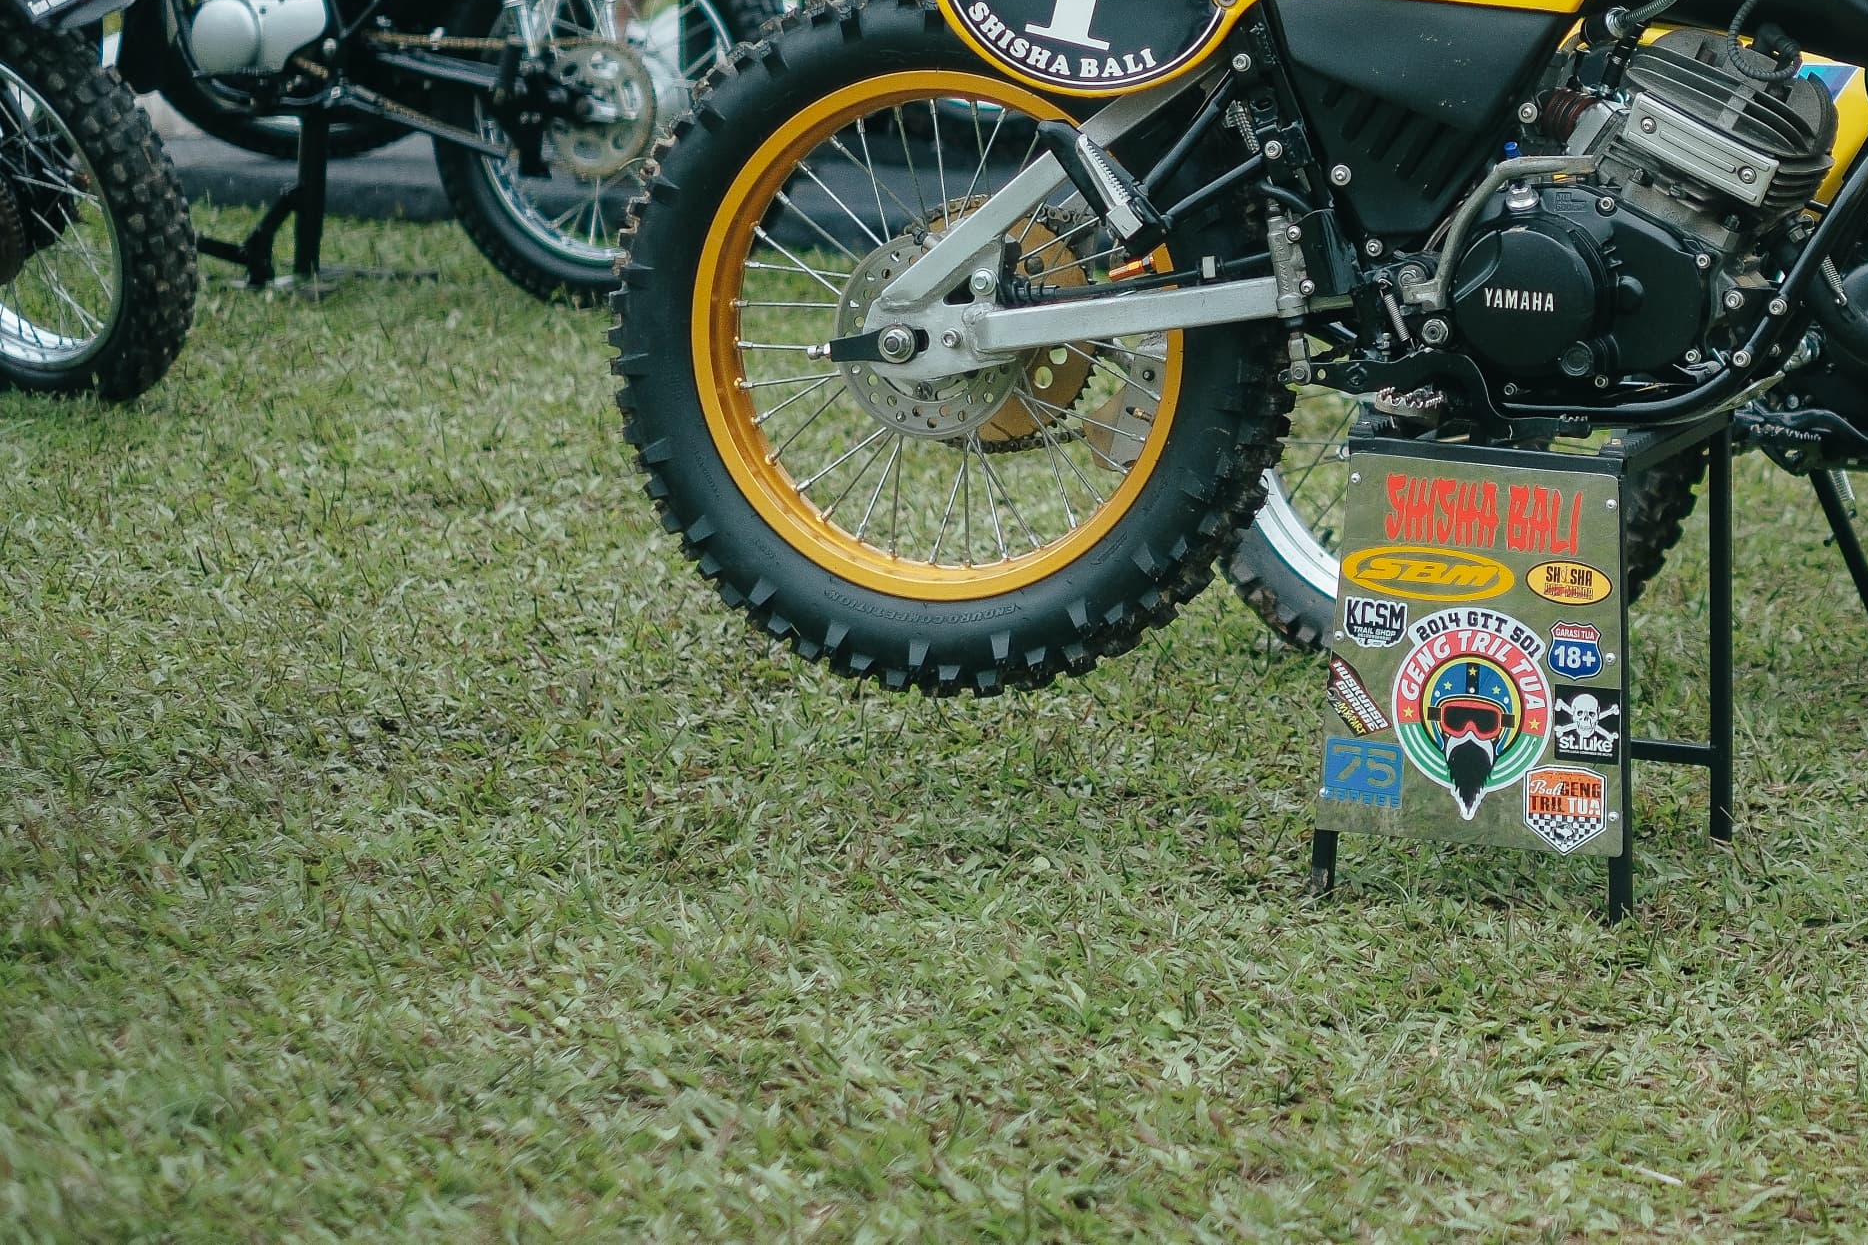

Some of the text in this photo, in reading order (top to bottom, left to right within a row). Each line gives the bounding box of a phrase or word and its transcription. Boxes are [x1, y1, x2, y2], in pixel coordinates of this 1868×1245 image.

[968, 1, 1158, 78] SHISHA BALI
[1484, 287, 1555, 313] YAMAHA
[1385, 473, 1583, 556] SHISHA BALI
[1355, 556, 1500, 587] SBM
[824, 586, 1018, 625] ENDURO COMPETITION
[1346, 598, 1406, 630] KCSM
[1353, 626, 1397, 637] TRAIL SHOP
[1416, 611, 1462, 642] 2014
[1467, 610, 1508, 634] GTT
[1555, 628, 1595, 640] GARASI TUA
[1401, 630, 1546, 710] GENG TRIL TUA
[1554, 645, 1596, 669] 18+
[1335, 680, 1380, 732] GARAGE
[1559, 735, 1613, 753] st.luke
[1333, 744, 1397, 787] 75
[1530, 779, 1601, 798] Bali GENG
[1530, 795, 1601, 816] TRIL TUA
